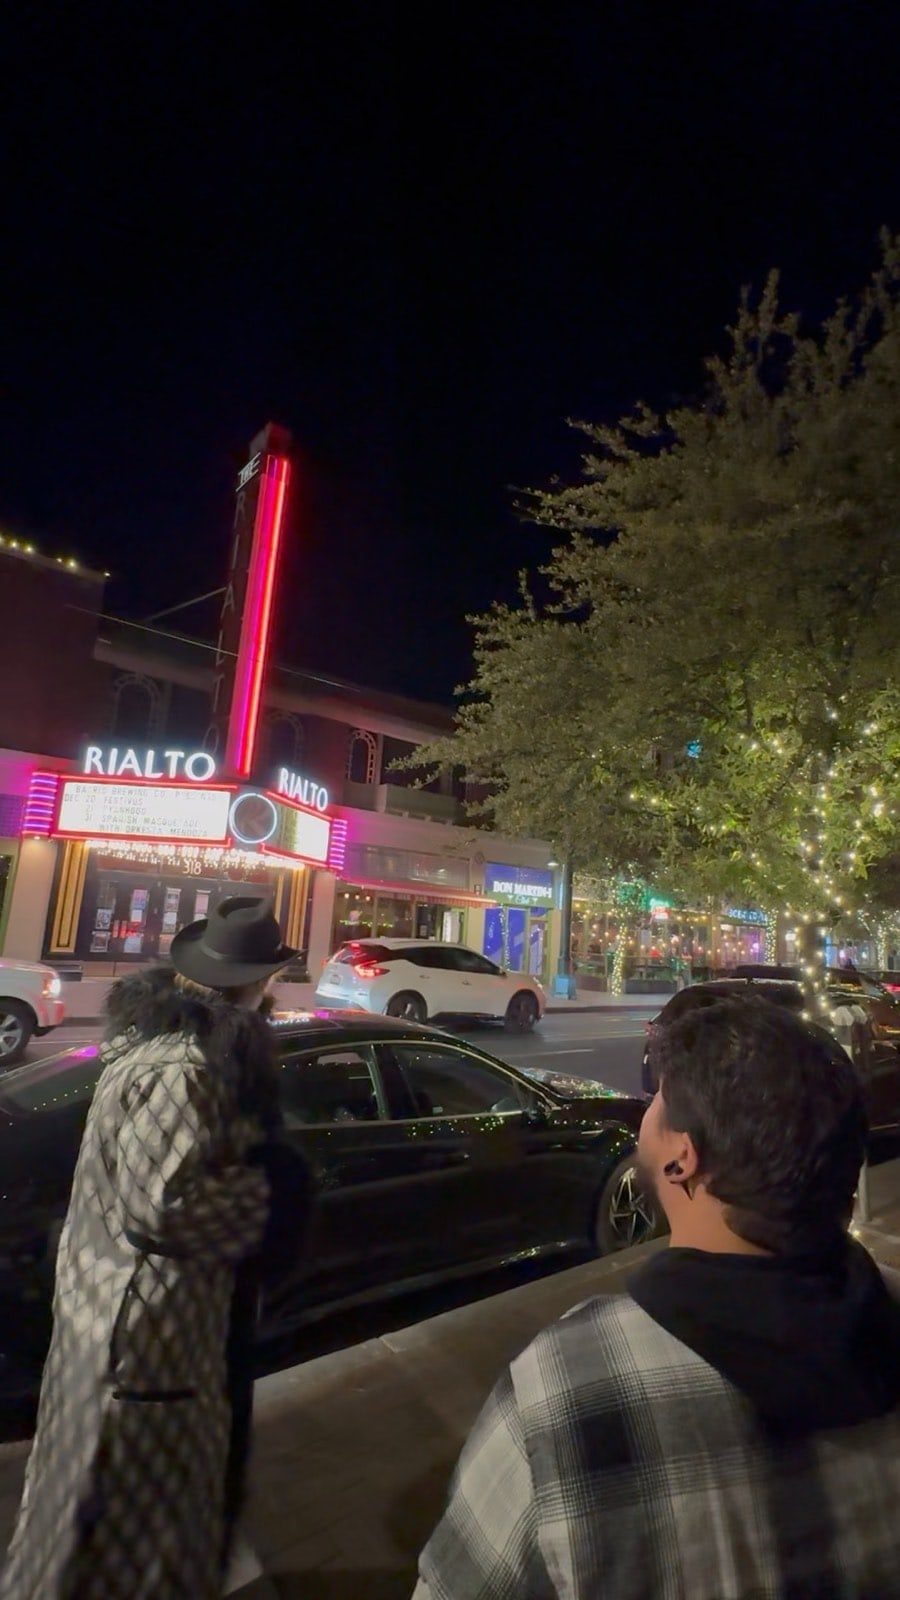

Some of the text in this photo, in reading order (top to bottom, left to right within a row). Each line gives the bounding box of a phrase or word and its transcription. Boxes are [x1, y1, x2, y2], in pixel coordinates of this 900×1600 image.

[84, 746, 215, 781] RIALTO
[278, 767, 329, 811] RIALTO
[64, 793, 80, 802] DEC
[103, 796, 144, 806] FESTIVUS
[182, 859, 202, 876] 318
[493, 880, 513, 893] DON
